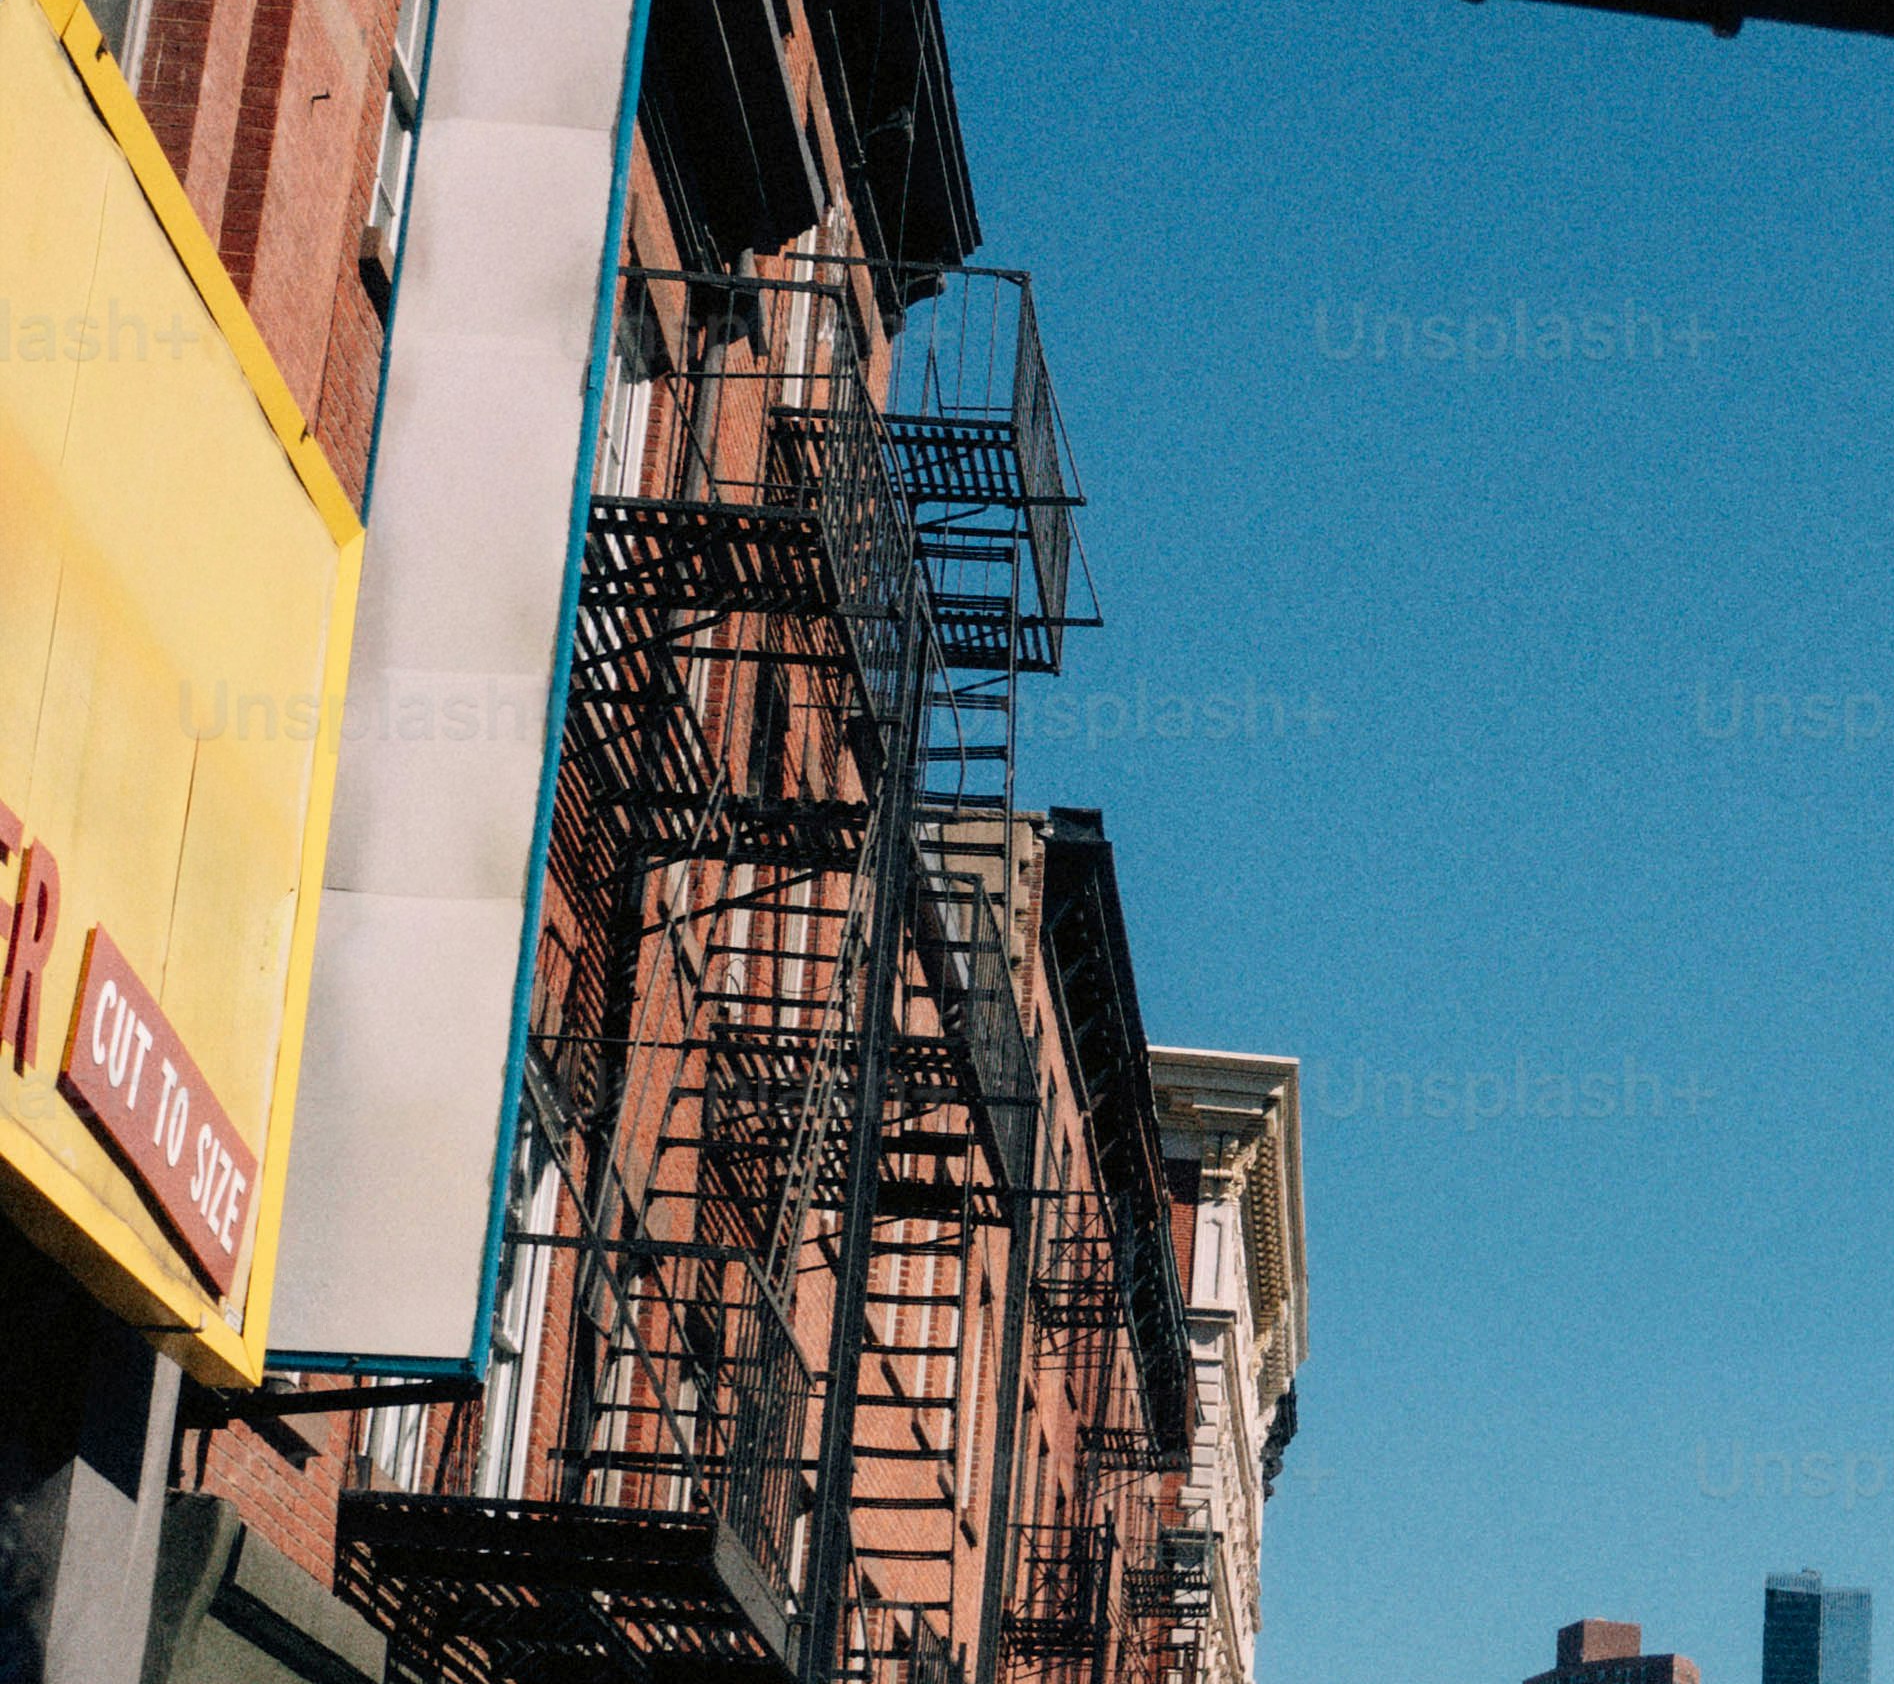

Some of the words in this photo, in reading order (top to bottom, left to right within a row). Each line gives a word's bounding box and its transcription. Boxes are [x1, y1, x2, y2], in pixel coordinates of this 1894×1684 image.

[91, 978, 152, 1110] CUT
[152, 1060, 190, 1168] TO
[190, 1121, 248, 1255] SIZE
